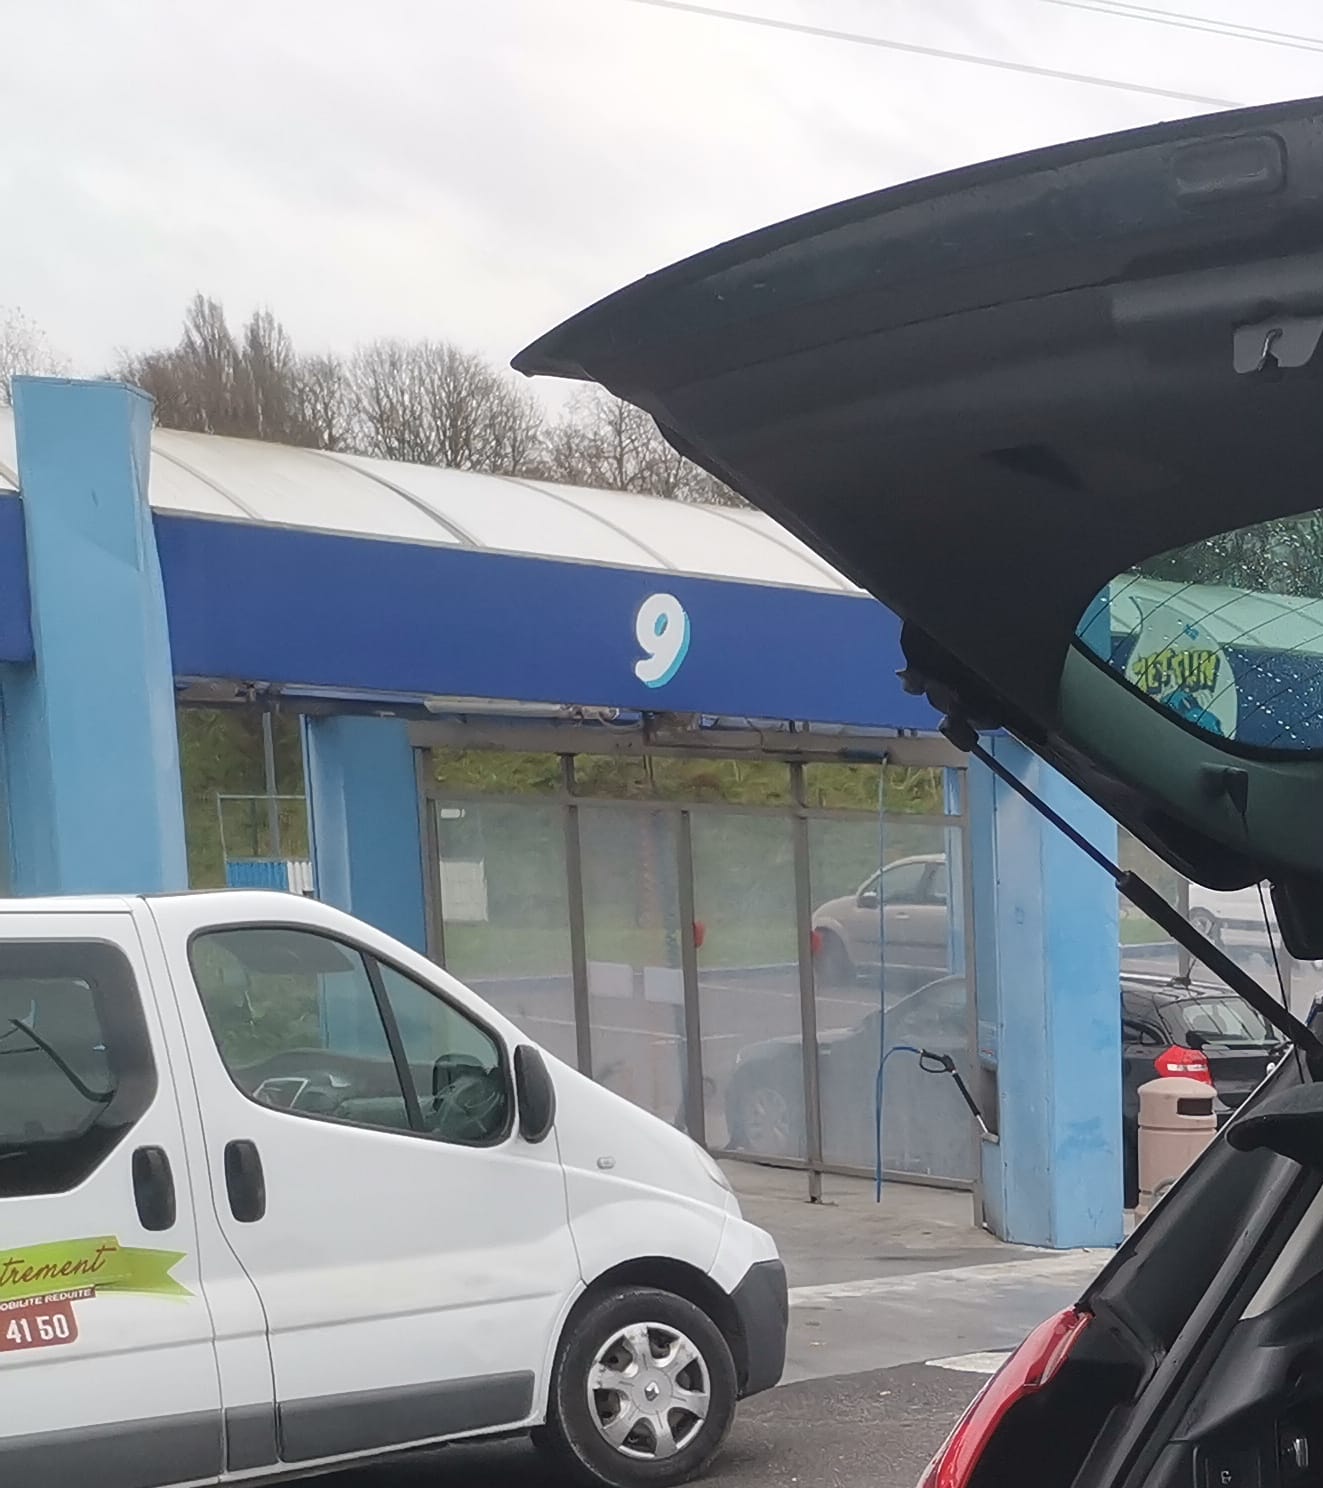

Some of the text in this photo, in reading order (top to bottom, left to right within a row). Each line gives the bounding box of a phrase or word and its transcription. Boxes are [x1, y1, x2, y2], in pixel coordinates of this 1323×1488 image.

[634, 592, 691, 689] 9
[5, 1313, 70, 1344] 41 50
